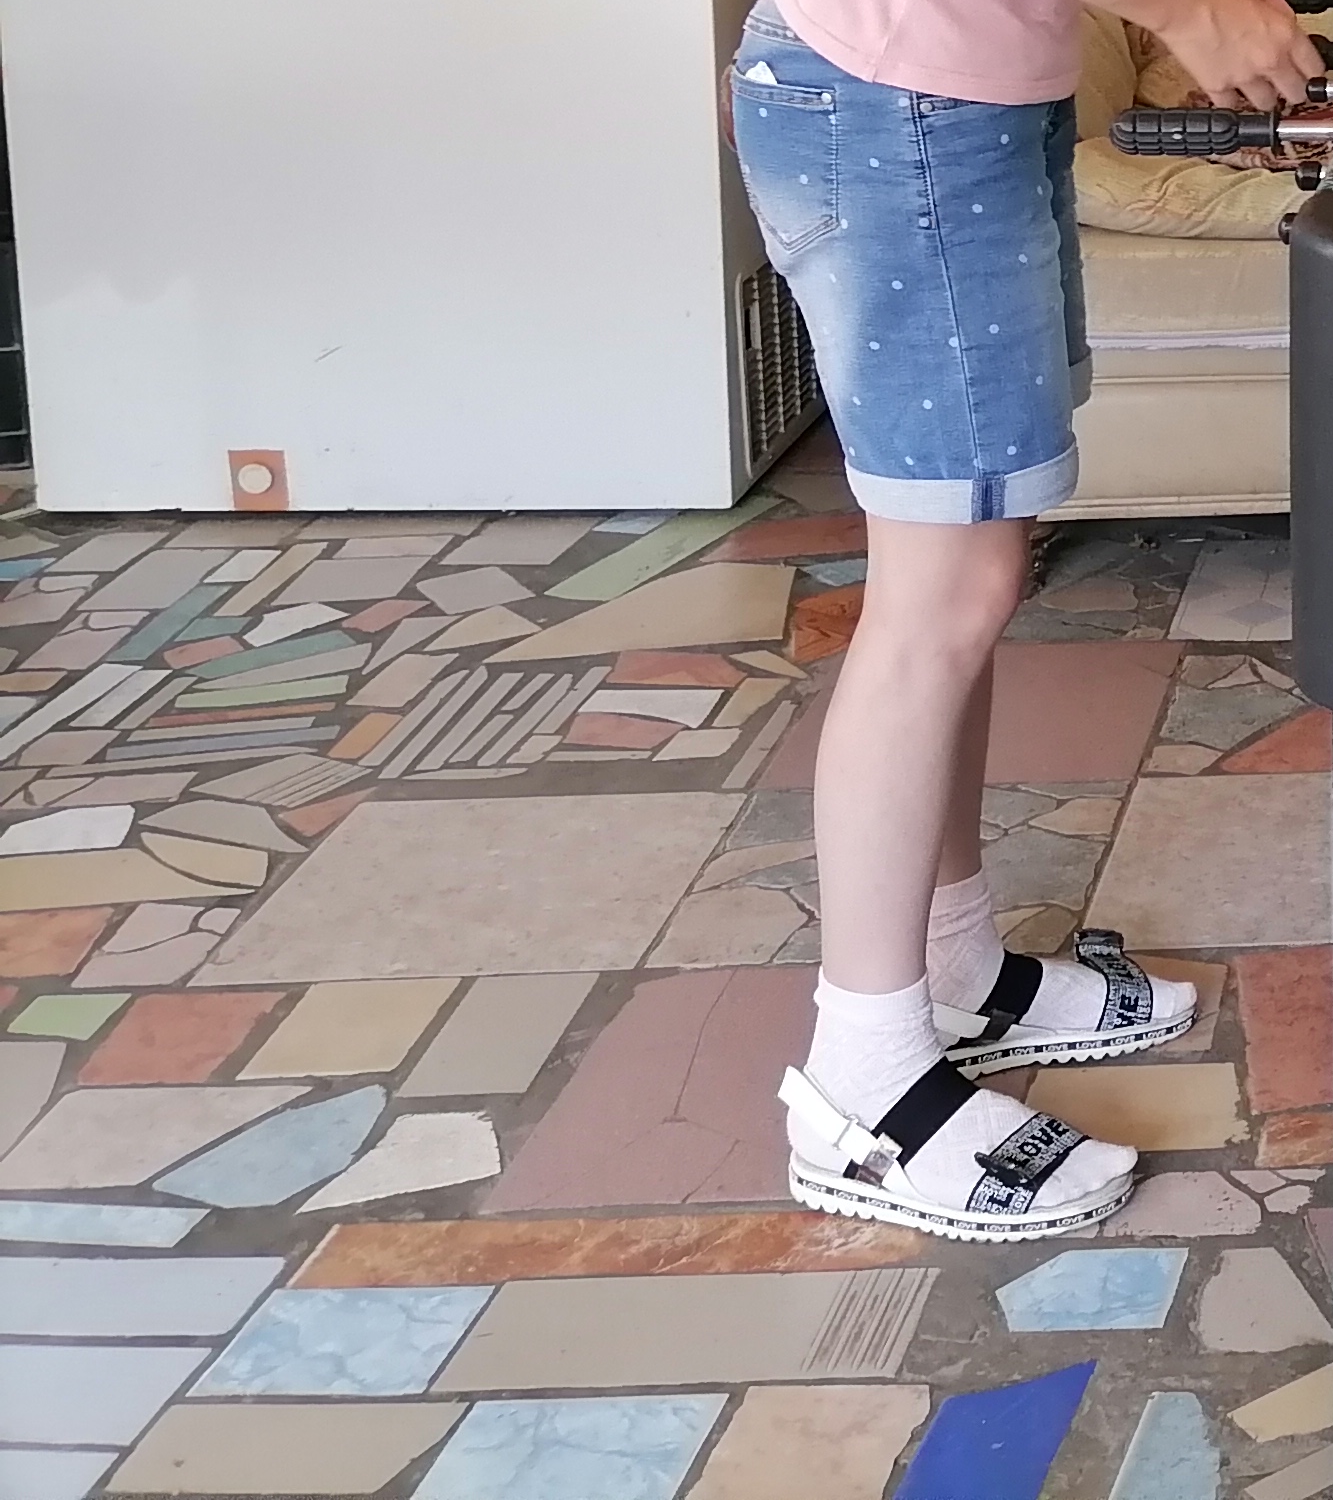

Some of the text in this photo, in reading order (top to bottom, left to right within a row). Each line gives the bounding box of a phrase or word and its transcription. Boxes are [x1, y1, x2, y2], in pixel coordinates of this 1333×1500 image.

[1009, 1046, 1035, 1057] LOVE
[1042, 1043, 1069, 1053] LOVE
[1075, 1040, 1103, 1050] LOVE
[1110, 1035, 1136, 1046] LOVE
[1142, 1028, 1168, 1040] LOVE
[925, 1213, 949, 1227] LOVE
[953, 1219, 978, 1231] LOVE
[983, 1223, 1012, 1233] LOVE
[1018, 1221, 1048, 1232] LOVE
[1056, 1214, 1085, 1227] LOVE
